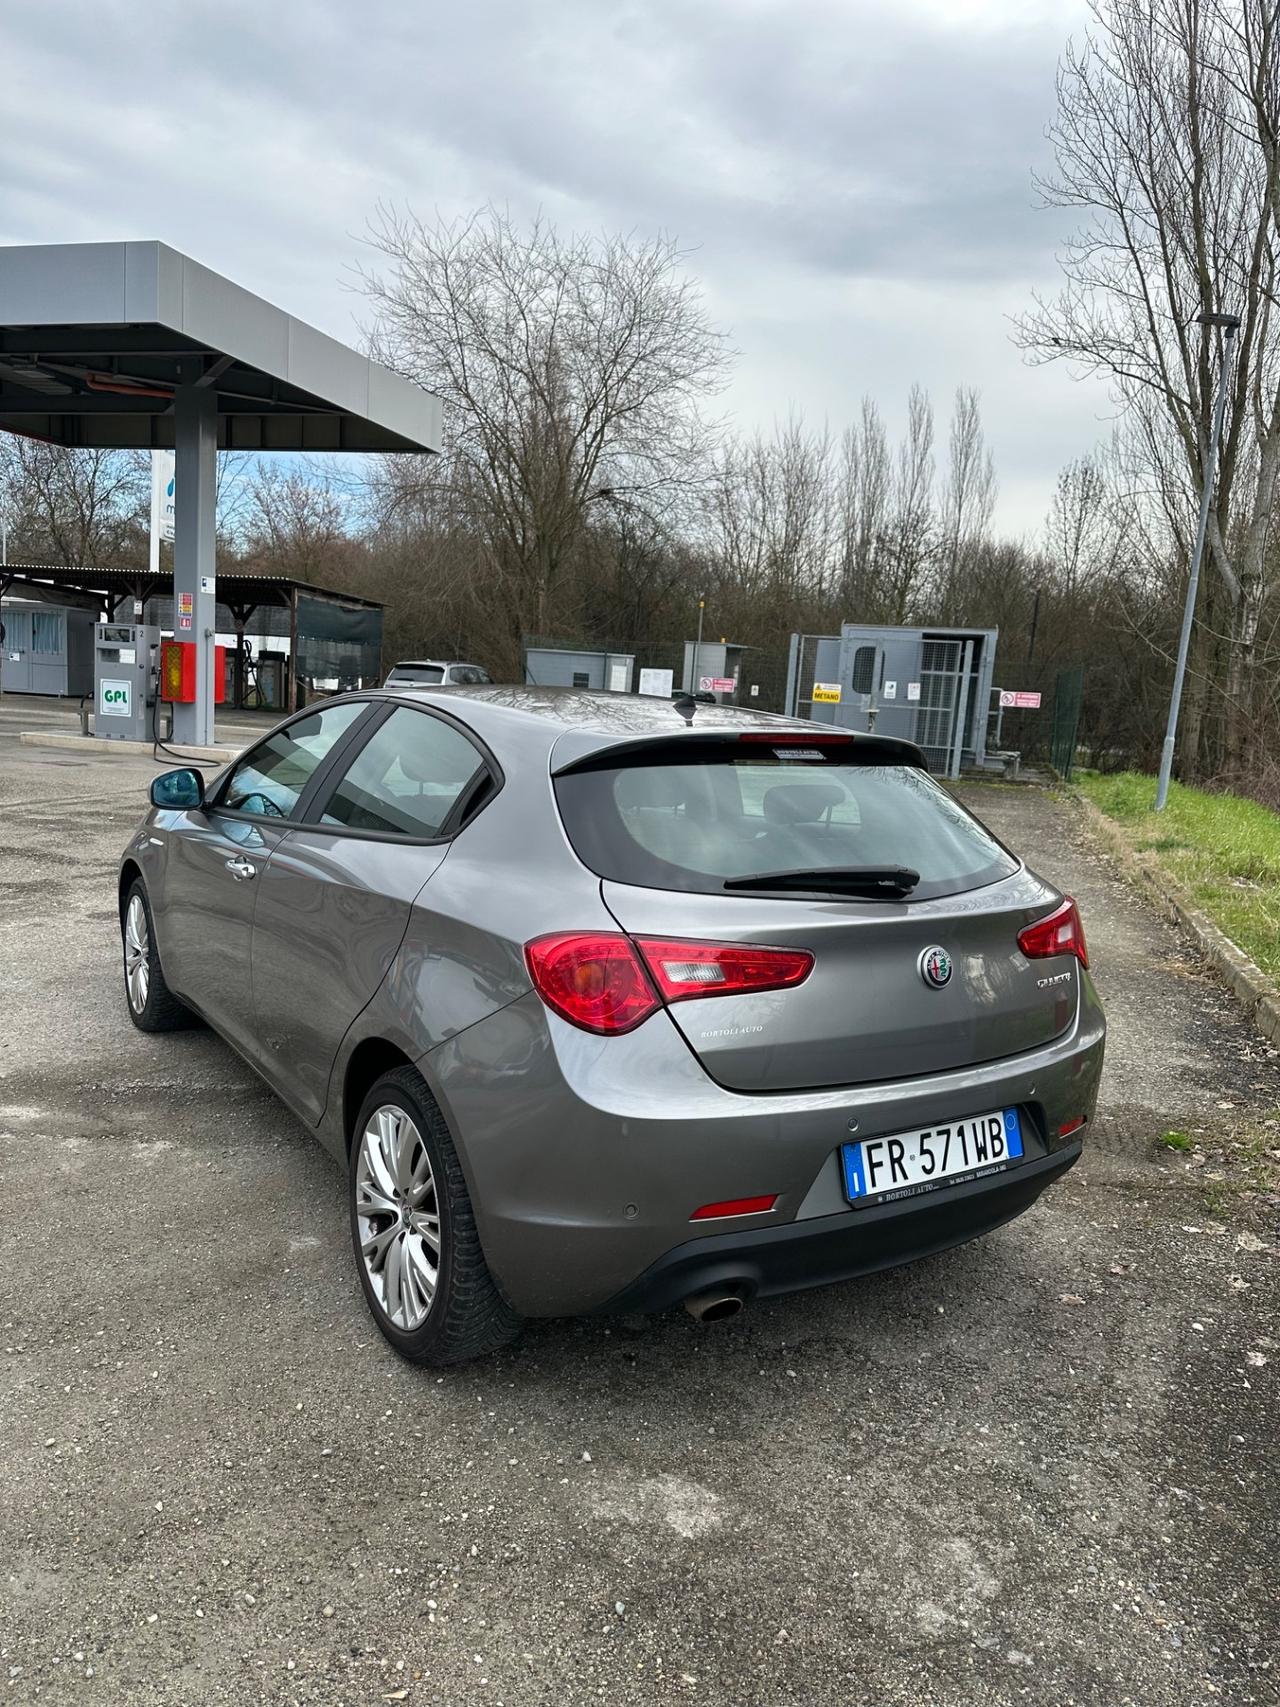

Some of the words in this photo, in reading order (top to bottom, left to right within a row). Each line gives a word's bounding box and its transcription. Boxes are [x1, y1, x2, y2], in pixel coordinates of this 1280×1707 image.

[104, 689, 128, 704] GPL
[814, 692, 839, 701] METANO
[701, 1027, 738, 1038] BORTOLI
[740, 1024, 763, 1034] AUTO
[866, 1138, 909, 1187] FR
[919, 1117, 1004, 1175] 571WB
[886, 1187, 915, 1201] BORTOLI
[916, 1183, 934, 1194] AUTO
